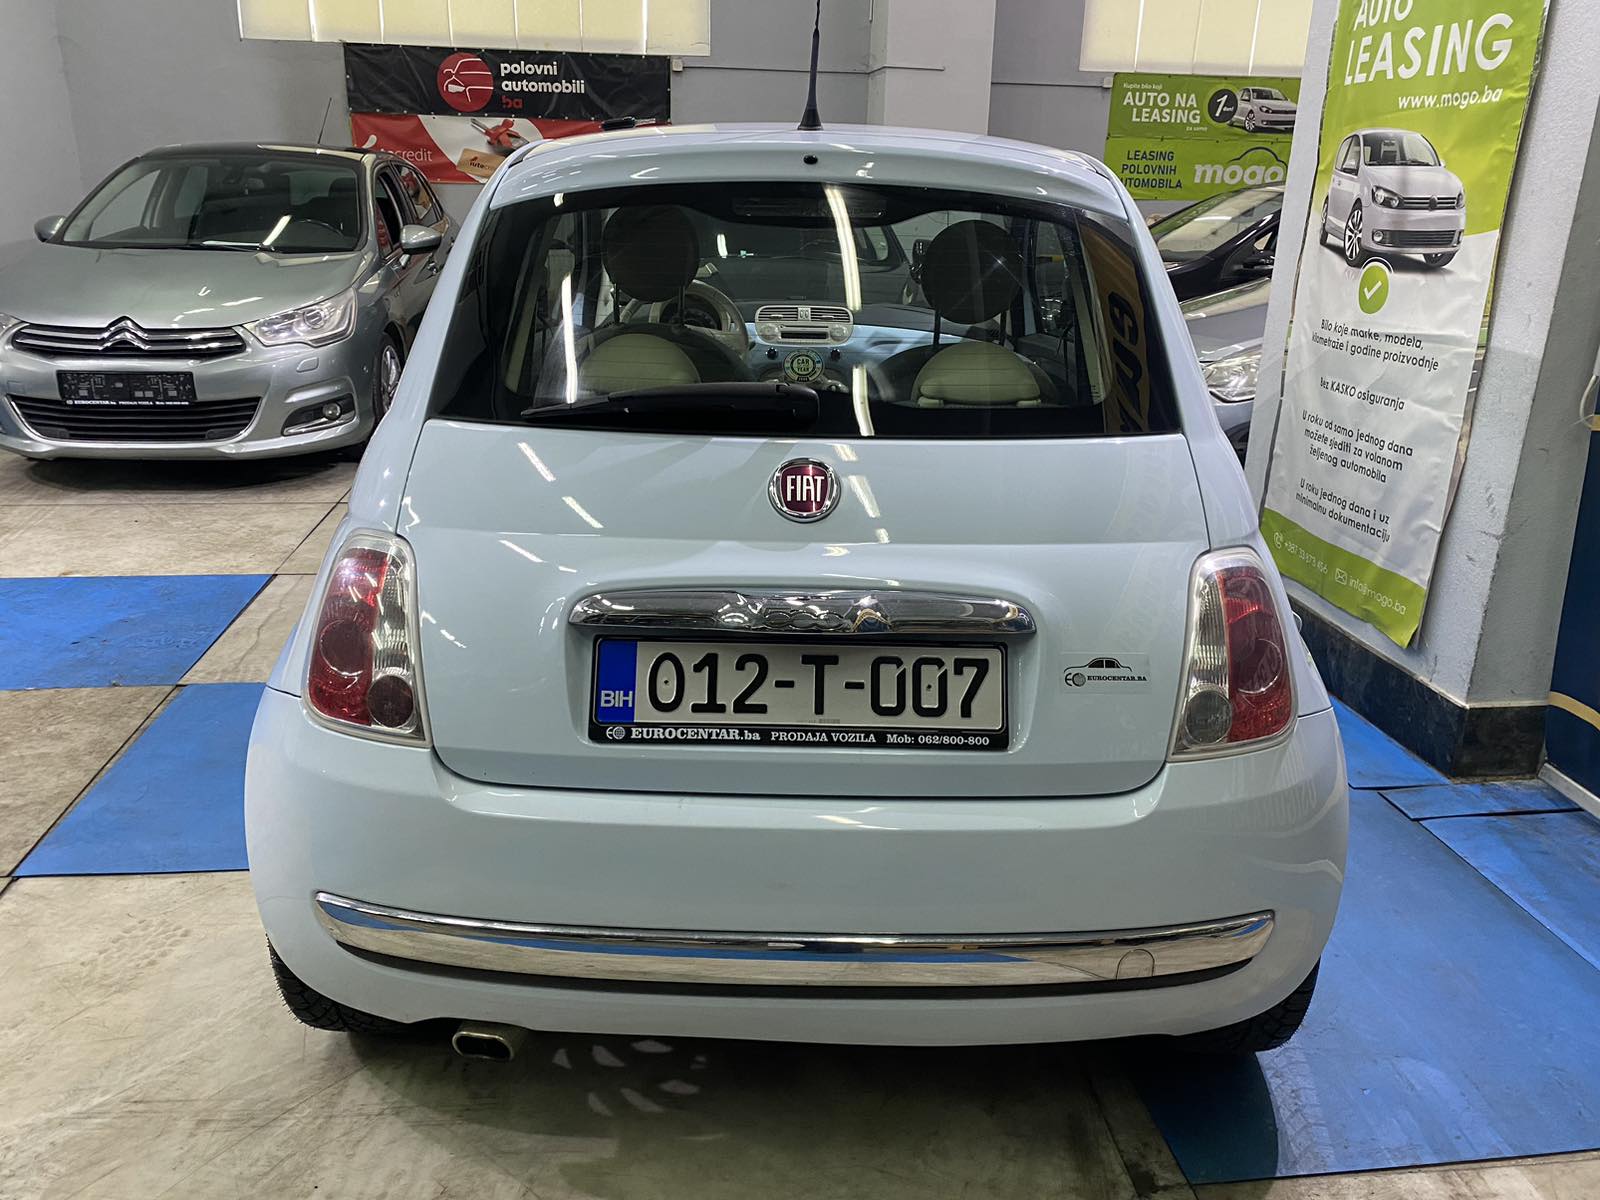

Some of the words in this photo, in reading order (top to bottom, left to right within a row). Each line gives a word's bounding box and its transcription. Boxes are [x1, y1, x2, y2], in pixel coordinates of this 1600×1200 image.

[1353, 0, 1413, 31] AUTO
[1344, 13, 1513, 86] LEASING
[500, 60, 557, 76] polovni
[502, 80, 584, 93] automobili
[1123, 91, 1170, 106] AUTO
[1175, 93, 1197, 108] NA
[1398, 85, 1503, 109] www.mogo.ba
[1132, 108, 1200, 124] LEASING
[1216, 94, 1228, 116] 1
[1127, 150, 1174, 161] LEASING
[1121, 164, 1176, 175] POLOVNIH
[1334, 322, 1348, 336] koje
[1351, 328, 1382, 342] marke,
[1385, 334, 1424, 350] modela,
[1350, 344, 1381, 358] godine
[1383, 351, 1438, 372] proizvodnje
[1330, 380, 1356, 397] KASKO
[1357, 390, 1404, 411] osiguranja
[1302, 410, 1307, 420] U
[1308, 414, 1324, 426] roku
[1325, 420, 1333, 430] od
[1334, 424, 1354, 437] samo
[1356, 429, 1385, 450] jednog
[1388, 440, 1413, 456] dana
[1305, 429, 1328, 444] možete
[1329, 438, 1352, 453] sjediti
[1354, 447, 1362, 456] za
[1366, 451, 1402, 470] volanom
[1310, 444, 1338, 467] željenog
[1341, 460, 1386, 482] automobila
[786, 475, 824, 502] FIAT
[1300, 478, 1306, 488] U
[1306, 482, 1318, 495] roku
[1320, 488, 1347, 510] jednog
[1349, 501, 1370, 517] dana
[1380, 513, 1390, 524] uz
[1296, 493, 1326, 514] minimalnu
[1328, 509, 1390, 542] dokumentaciju
[648, 652, 990, 718] 012-T-007
[600, 690, 632, 708] BIH
[631, 728, 760, 740] EUROCENTAR.ba
[770, 732, 828, 742] PRODAJA
[831, 733, 876, 743] VOZILA
[886, 734, 914, 744] Mob:
[918, 735, 990, 746] 062/800-800
